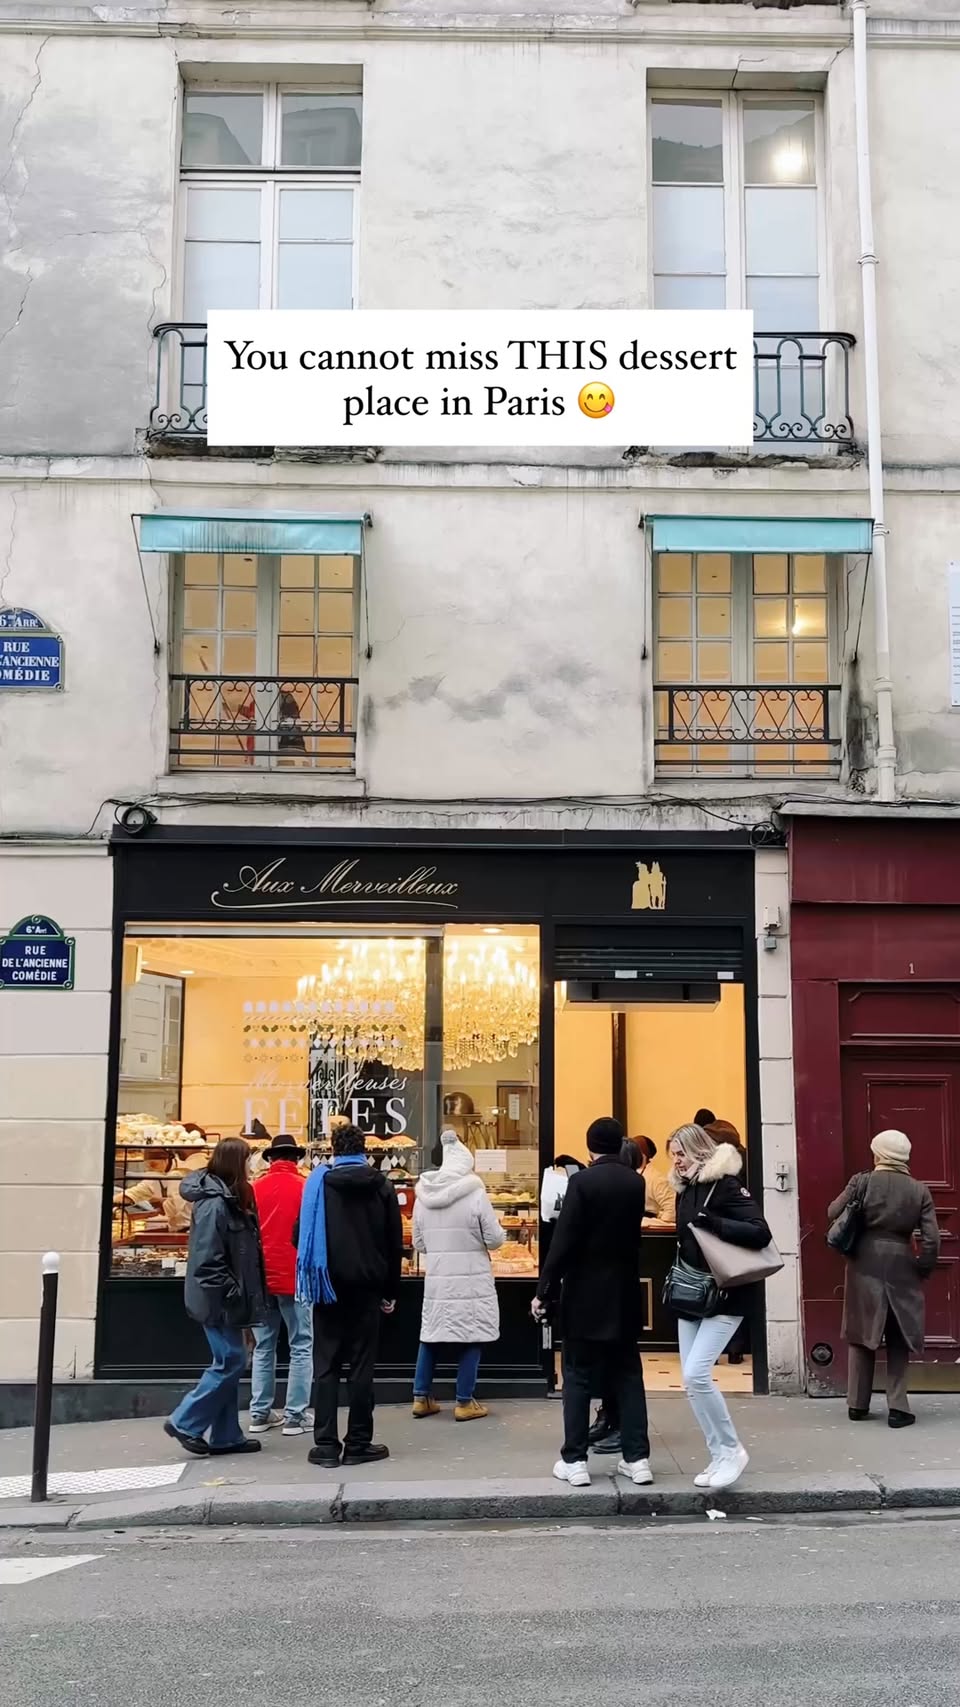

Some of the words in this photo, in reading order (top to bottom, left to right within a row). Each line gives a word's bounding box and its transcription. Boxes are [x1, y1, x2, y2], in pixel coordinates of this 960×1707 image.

[3, 641, 30, 653] RUE
[0, 667, 50, 681] MÉDIE
[222, 857, 295, 893] Aux
[300, 858, 459, 895] Merveilleux
[24, 945, 47, 955] RUE
[2, 958, 14, 968] DE
[15, 958, 68, 968] L'ANCIENNE
[908, 962, 915, 975] 1
[12, 968, 57, 981] COMÉDIE
[243, 1091, 408, 1136] FÊTES
